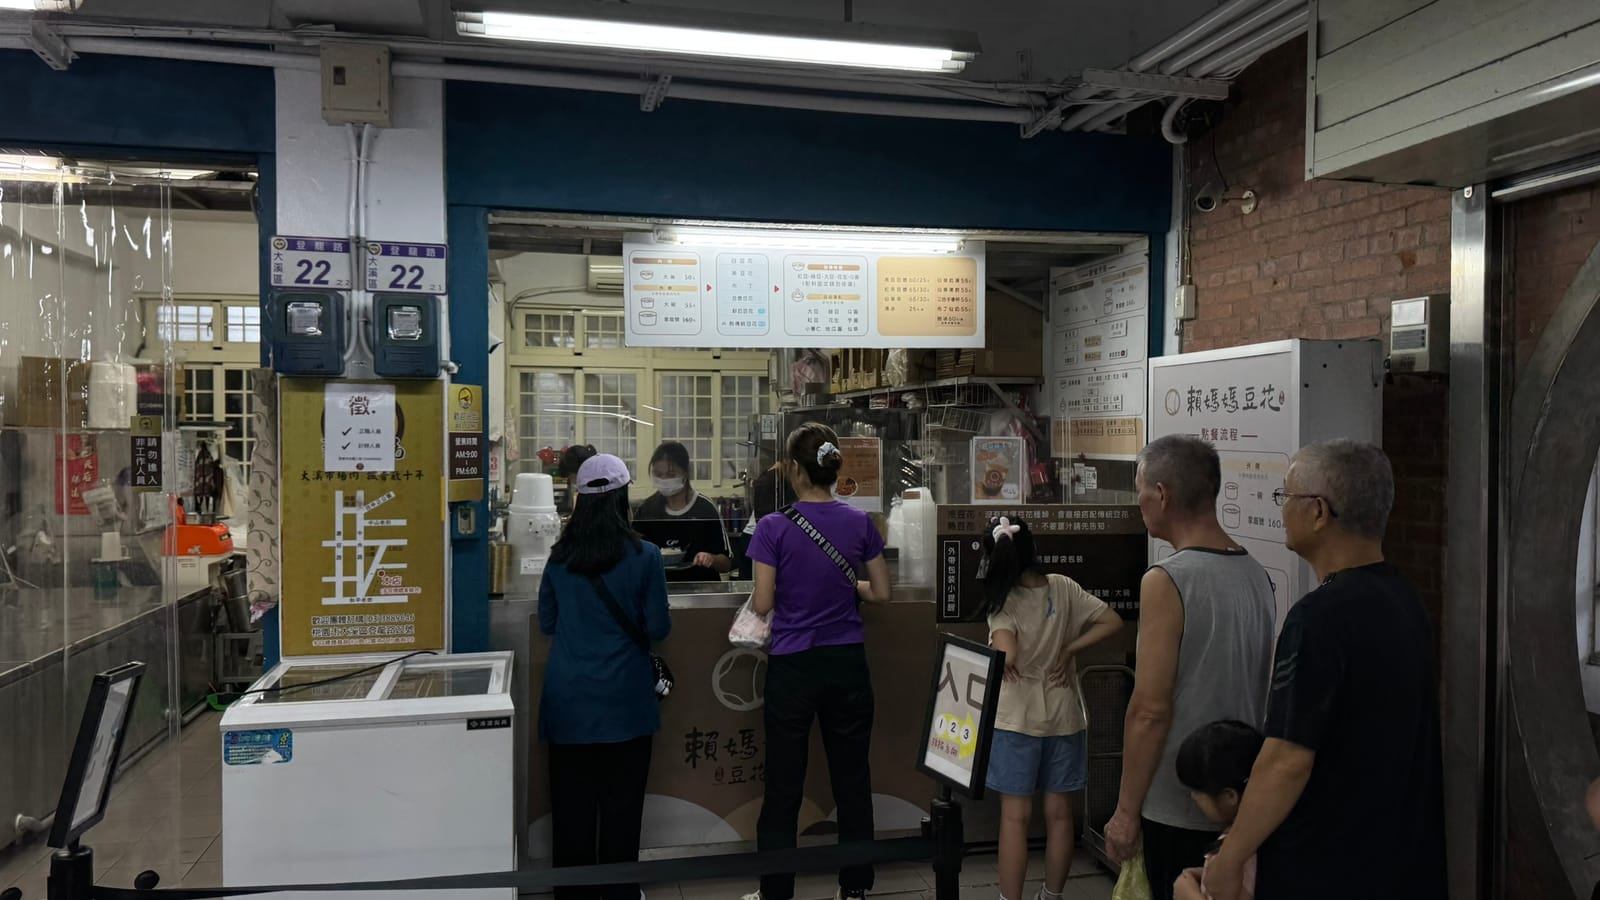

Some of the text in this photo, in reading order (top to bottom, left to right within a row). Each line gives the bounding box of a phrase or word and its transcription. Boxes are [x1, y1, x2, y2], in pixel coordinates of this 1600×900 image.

[296, 239, 344, 253] 登龍路
[390, 245, 437, 257] 登龍路
[273, 252, 284, 285] 大溪區
[294, 258, 332, 286] 22
[368, 256, 379, 289] 大溪區
[388, 263, 425, 290] 22
[1187, 384, 1280, 417] 賴媽媽豆花
[1201, 427, 1238, 441] 點餐流程
[135, 436, 147, 486] 非工作人員
[147, 436, 158, 486] 請勿進入
[938, 662, 987, 711] 入口
[685, 726, 766, 769] 賴媽
[963, 728, 970, 740] 3
[728, 762, 767, 785] 豆花
